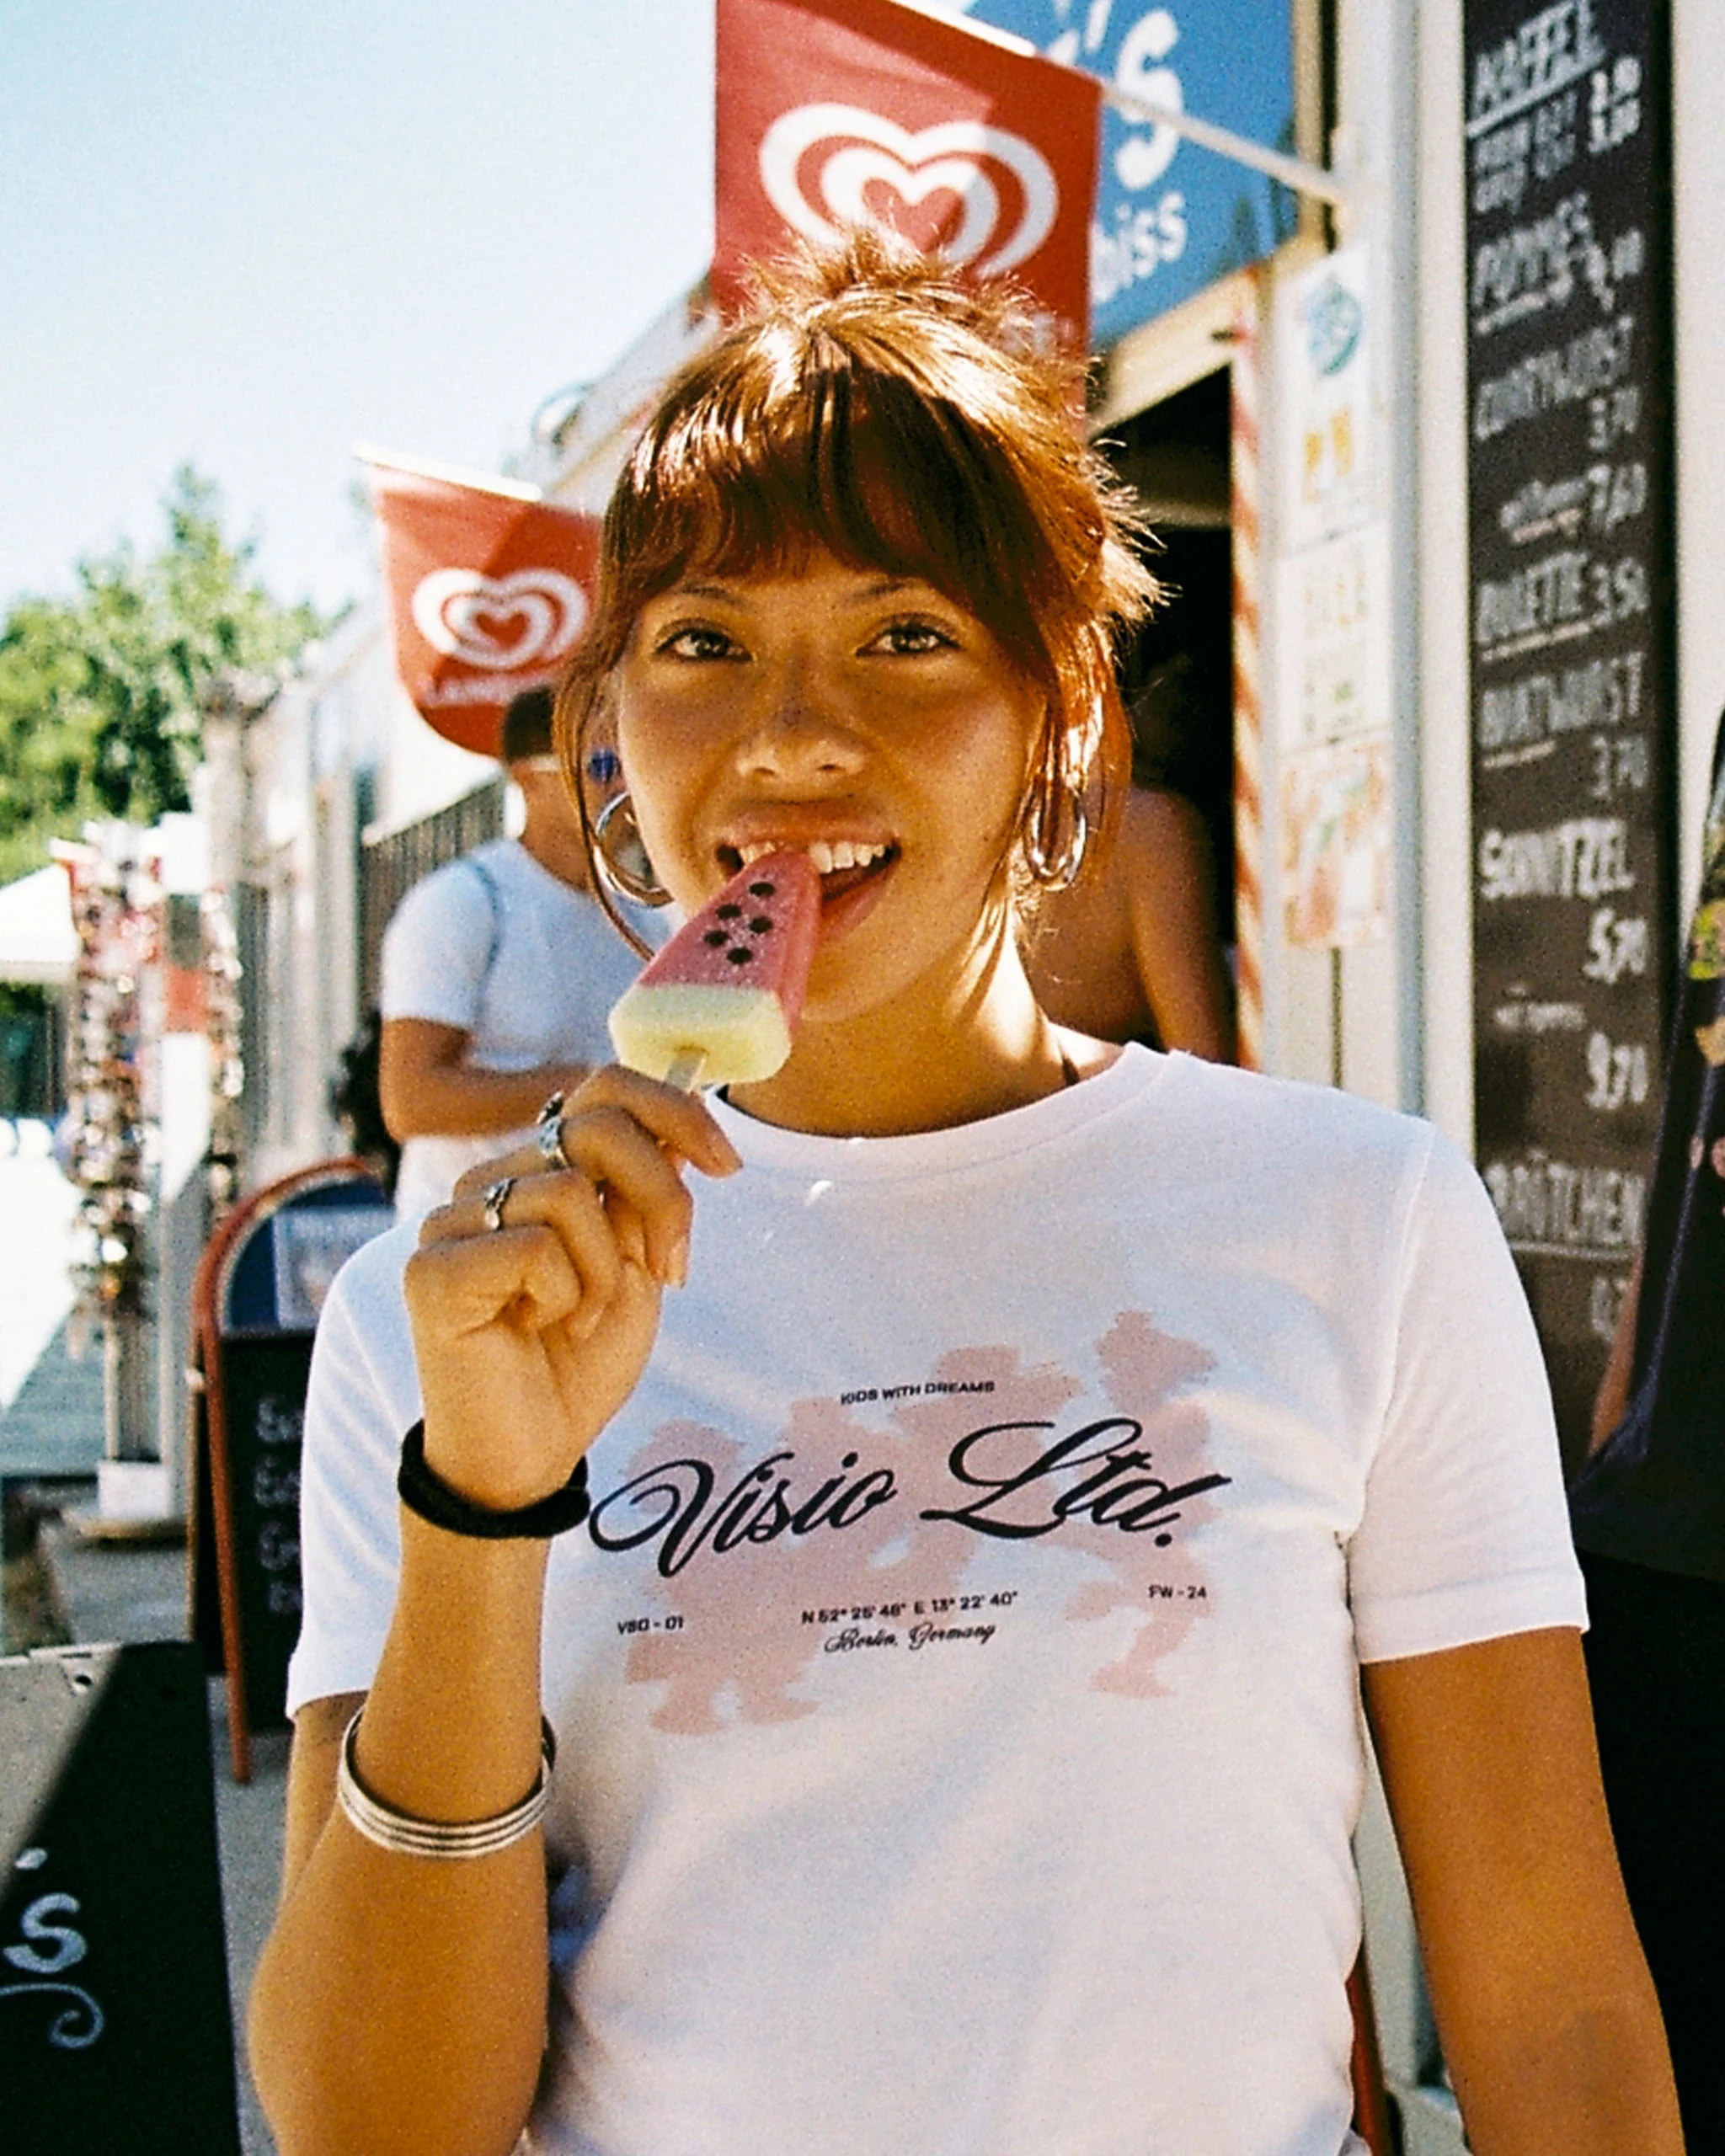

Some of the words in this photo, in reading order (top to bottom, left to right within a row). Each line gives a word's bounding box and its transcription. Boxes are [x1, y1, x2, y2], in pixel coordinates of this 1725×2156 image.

[841, 1389, 878, 1406] KIDS
[881, 1384, 921, 1400] WITH
[925, 1380, 995, 1395] DREAMS
[588, 1451, 897, 1577] Visio
[919, 1417, 1231, 1547] Ltd.
[1148, 1584, 1172, 1599] FW
[1188, 1585, 1207, 1599] 24
[802, 1610, 814, 1624] N
[914, 1600, 925, 1614] E
[825, 1628, 899, 1652] Berlin,
[909, 1621, 996, 1651] Germany
